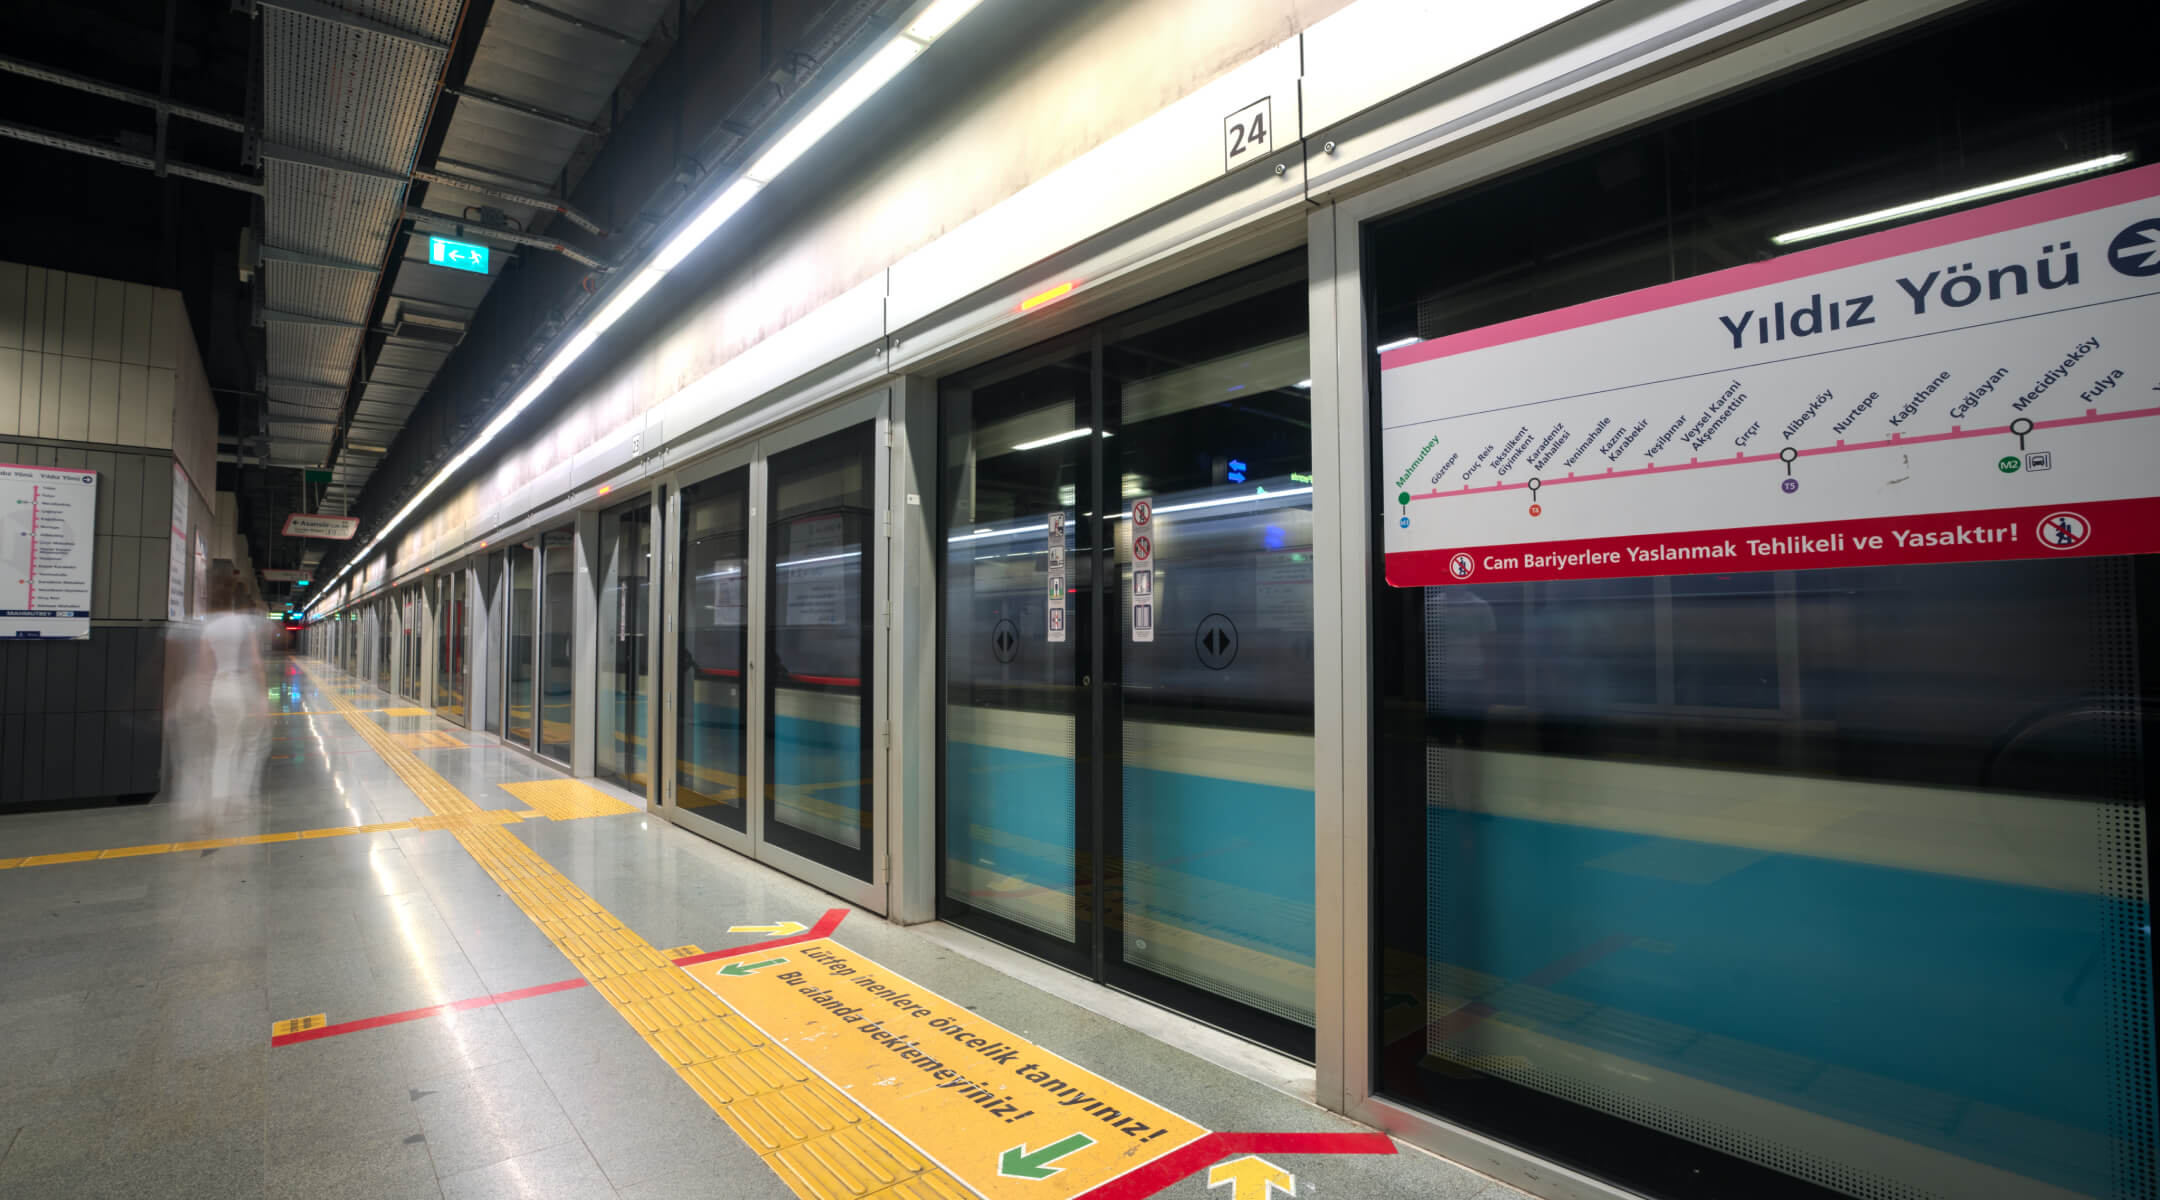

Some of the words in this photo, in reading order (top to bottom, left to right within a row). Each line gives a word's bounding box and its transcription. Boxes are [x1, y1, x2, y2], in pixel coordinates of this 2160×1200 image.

[1229, 112, 1267, 158] 24
[1718, 293, 1875, 349] Yıldız
[1895, 240, 2079, 315] Yönü
[1950, 367, 2009, 418] Çağlayan
[2011, 336, 2100, 411] Mecidiyeköy
[2080, 369, 2124, 402] Fulya
[1680, 411, 1712, 443] Veysel
[1708, 379, 1741, 413] Karani
[1782, 389, 1834, 440] Alibeyköy
[1832, 391, 1880, 434] Nurtepe
[1888, 371, 1951, 427] Kağıthane
[1526, 421, 1564, 464] Karadeniz
[1563, 416, 1611, 468] Yenimahalle
[1600, 426, 1627, 455] Kazım
[1608, 418, 1648, 462] Karabekir
[1644, 414, 1687, 458] Yeşilpınar
[1691, 393, 1748, 451] Akşemsettin
[1734, 421, 1760, 447] Çırçır
[1396, 434, 1439, 488] Mahmutbey
[1431, 452, 1459, 484] Göztepe
[1462, 461, 1480, 481] Oruç
[1477, 444, 1494, 462] Reis
[1489, 426, 1528, 469] Tekstilkent
[1498, 434, 1535, 476] Giyimkent
[1534, 430, 1570, 471] Mahallesi
[2000, 460, 2019, 469] M2
[1784, 482, 1796, 490] T5
[1483, 556, 1519, 570] Cam
[1524, 549, 1620, 571] Bariyerlere
[1626, 540, 1737, 562] Yaslanmak
[1746, 533, 1844, 556] Tehlikeli
[1852, 535, 1883, 550] ve
[1891, 523, 2018, 548] Yasaktır!
[776, 971, 808, 986] Bu
[798, 986, 863, 1024] alanda
[857, 1020, 1035, 1123] beklemeyiniz!
[800, 946, 856, 976] Lütfen
[850, 974, 932, 1018] inenlere
[928, 1016, 1019, 1065] öncelik
[1015, 1064, 1168, 1143] tanıyınız!
